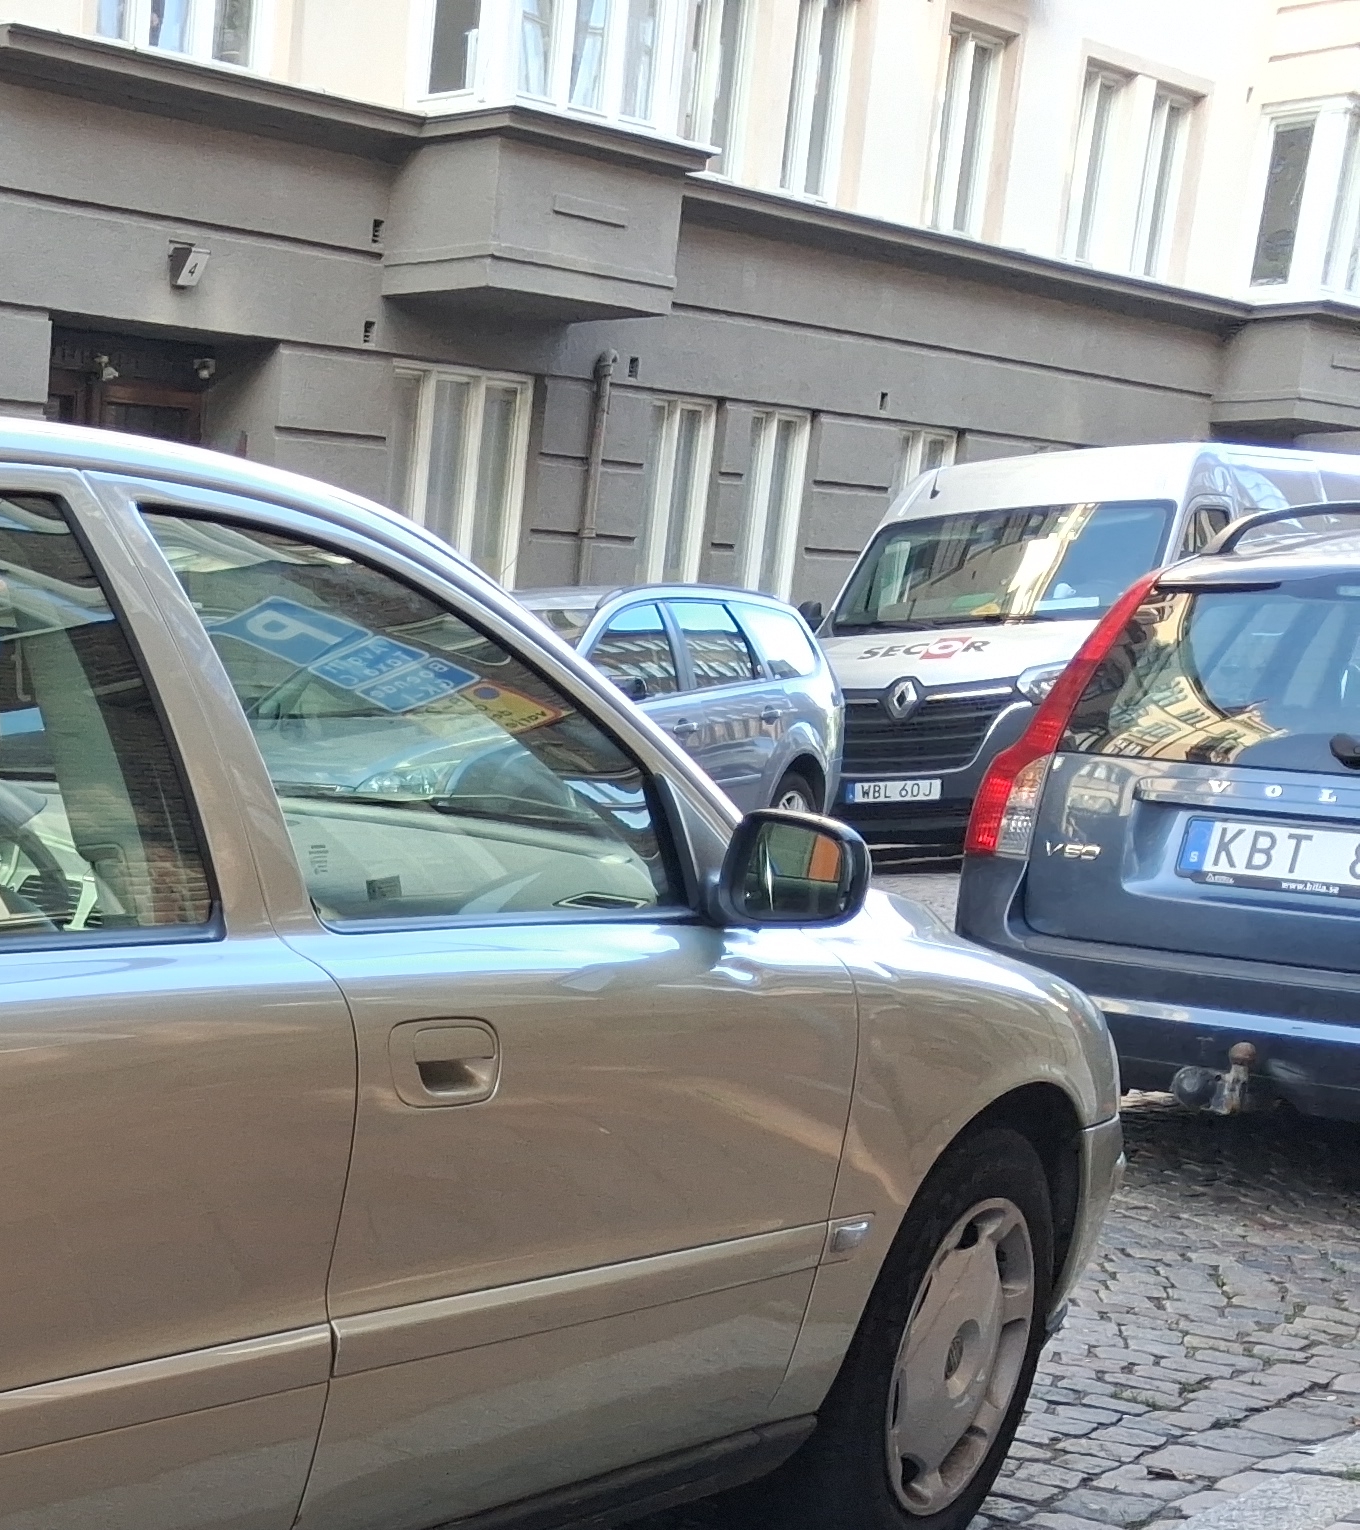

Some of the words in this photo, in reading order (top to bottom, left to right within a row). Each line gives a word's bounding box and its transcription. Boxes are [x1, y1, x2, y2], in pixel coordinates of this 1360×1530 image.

[187, 262, 199, 278] 4
[857, 638, 991, 660] SECOR
[861, 784, 891, 799] WBL
[1208, 779, 1338, 802] VOL
[1046, 840, 1101, 861] V50
[1188, 851, 1199, 863] S
[1212, 827, 1314, 874] KBT
